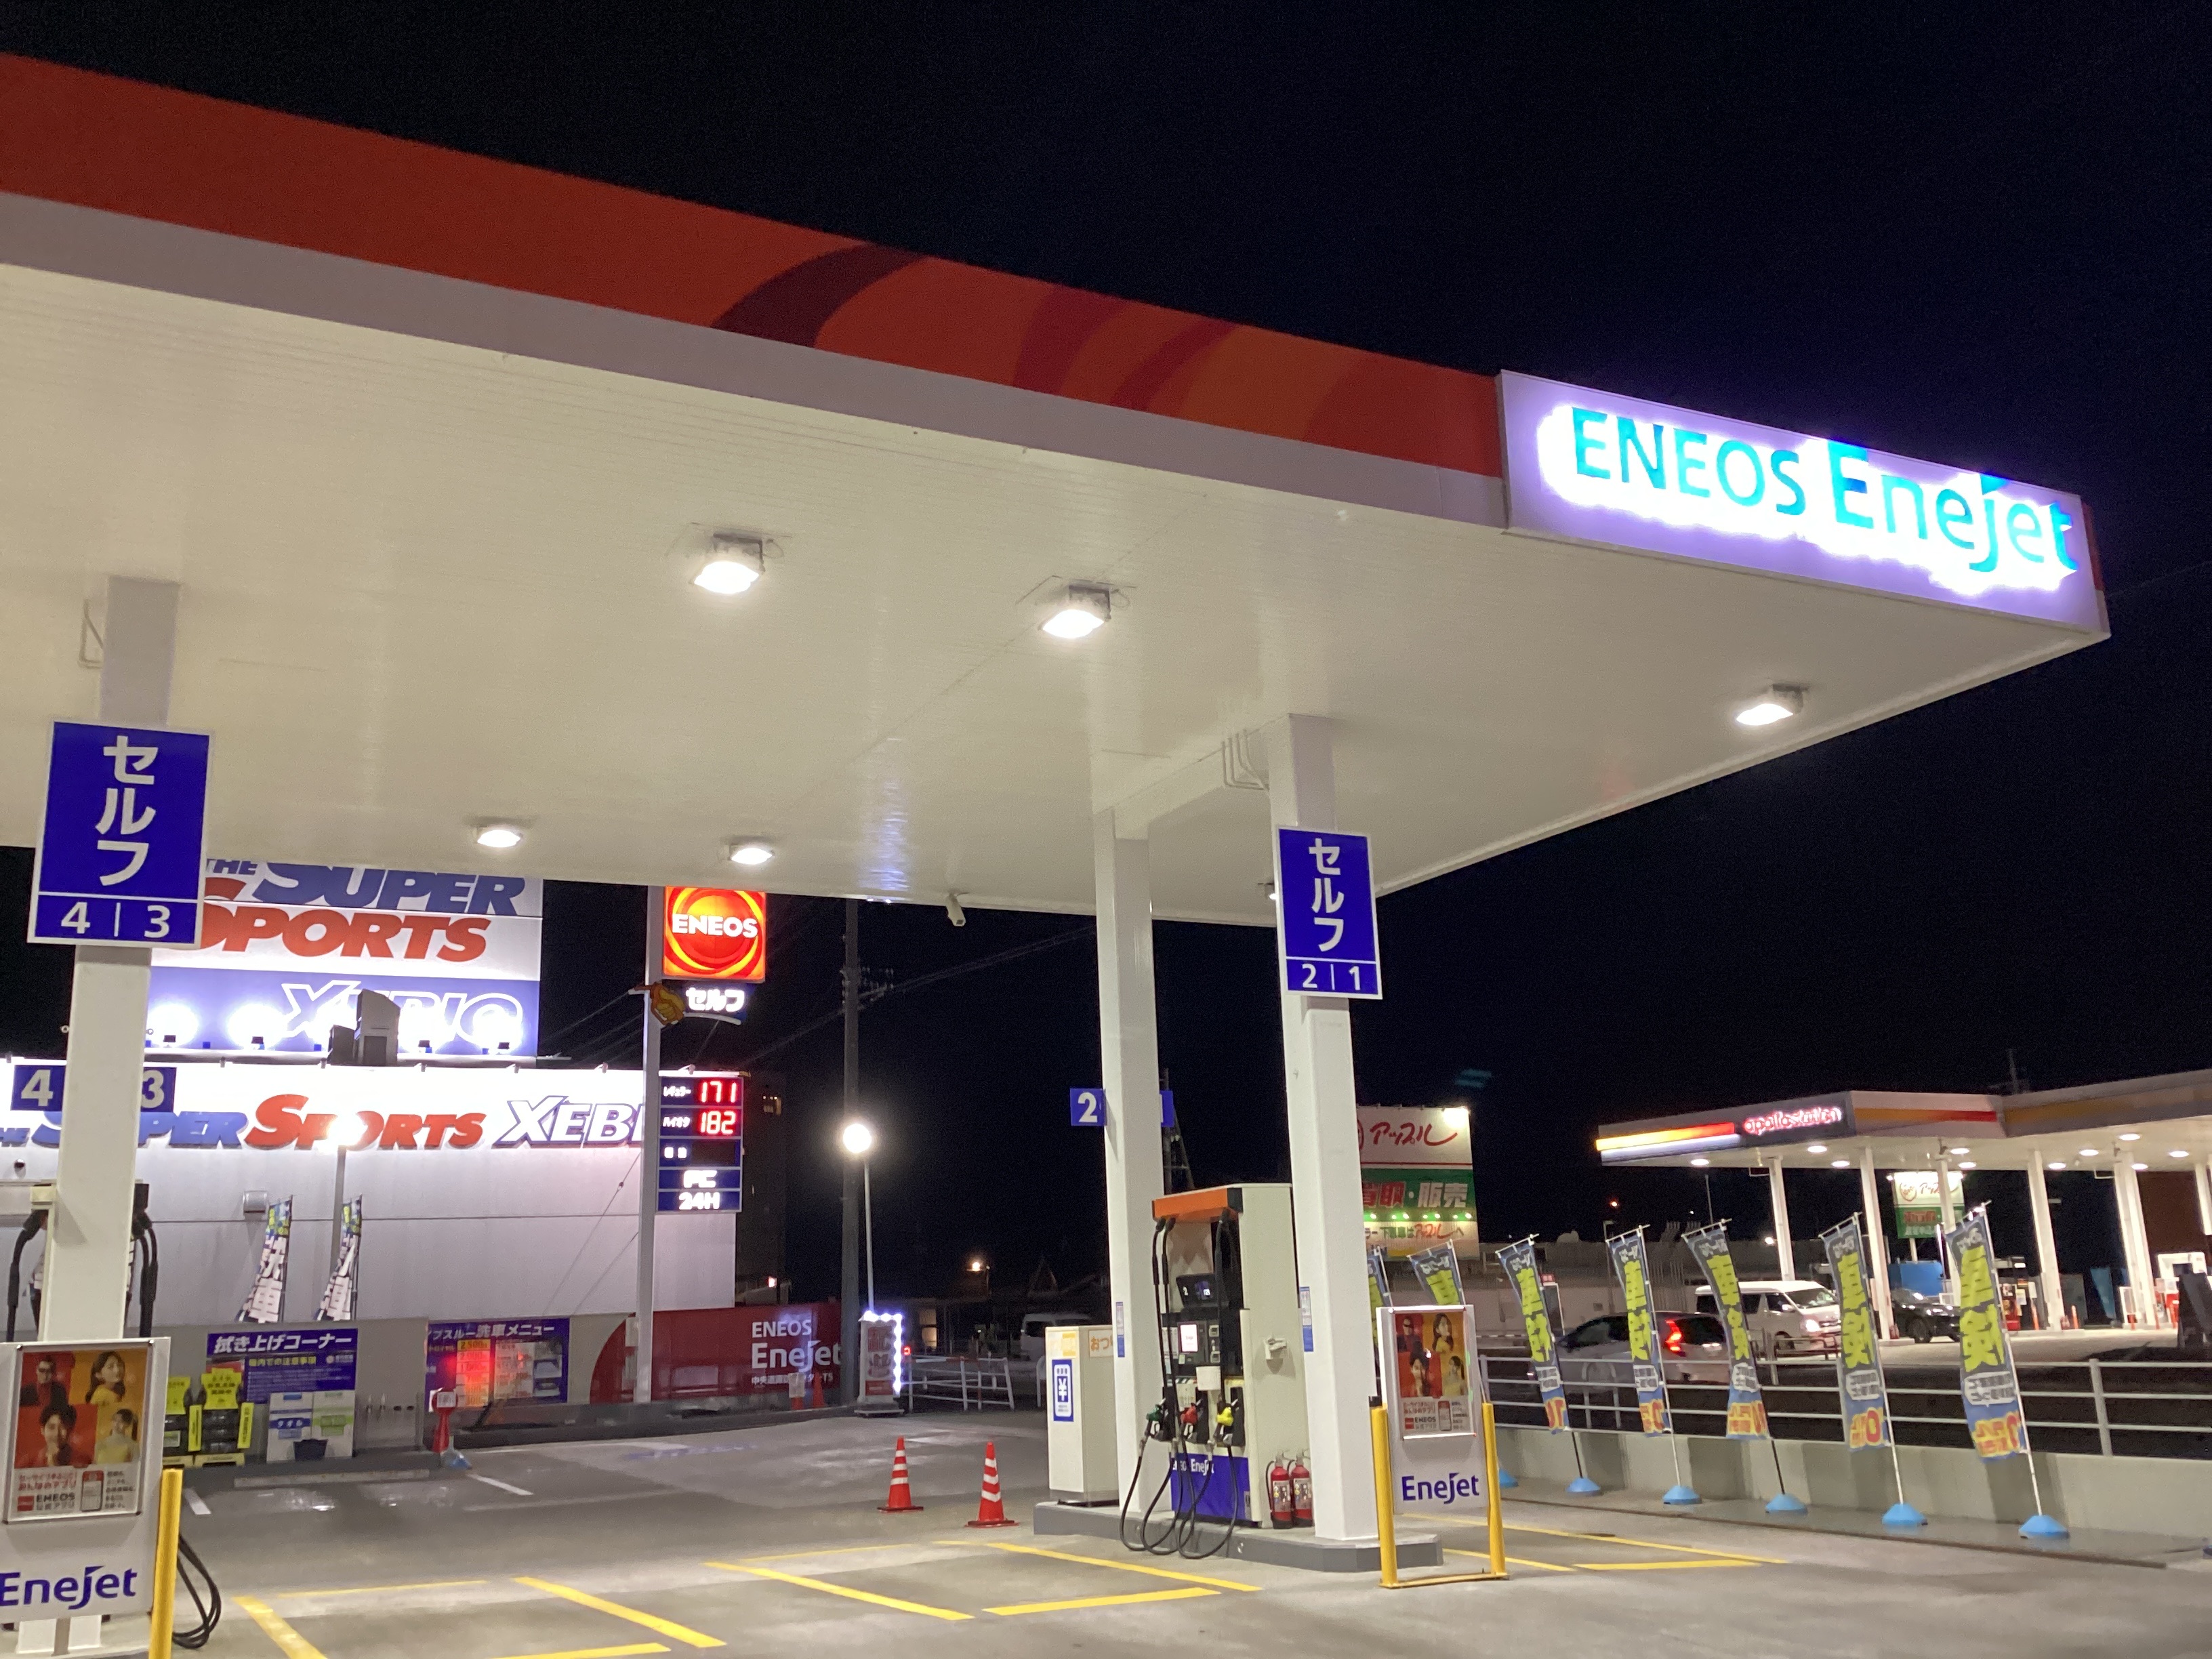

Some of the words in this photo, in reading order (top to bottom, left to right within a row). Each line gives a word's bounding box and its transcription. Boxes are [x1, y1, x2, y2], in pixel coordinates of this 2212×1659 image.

[1572, 407, 1805, 516] ENEOS
[1828, 439, 2078, 573] Enejet
[96, 735, 159, 886] セルフ
[252, 863, 525, 916] SUPER
[1309, 838, 1345, 952] セルフ
[60, 902, 91, 935] 4
[144, 905, 169, 939] 3
[672, 914, 758, 939] ENEOS
[1302, 963, 1318, 989] 2
[1349, 966, 1361, 990] 1
[685, 987, 745, 1012] セルフ
[21, 1069, 54, 1107] 4
[141, 1070, 164, 1109] 3
[700, 1080, 737, 1103] 171
[700, 1110, 736, 1134] 182
[1077, 1092, 1098, 1123] 2
[213, 1333, 352, 1354] 拭き上げコーナー
[752, 1319, 812, 1338] ENEOS
[752, 1340, 842, 1373] Enejet
[1401, 1473, 1480, 1504] Enejet
[0, 1565, 138, 1610] Enejet
